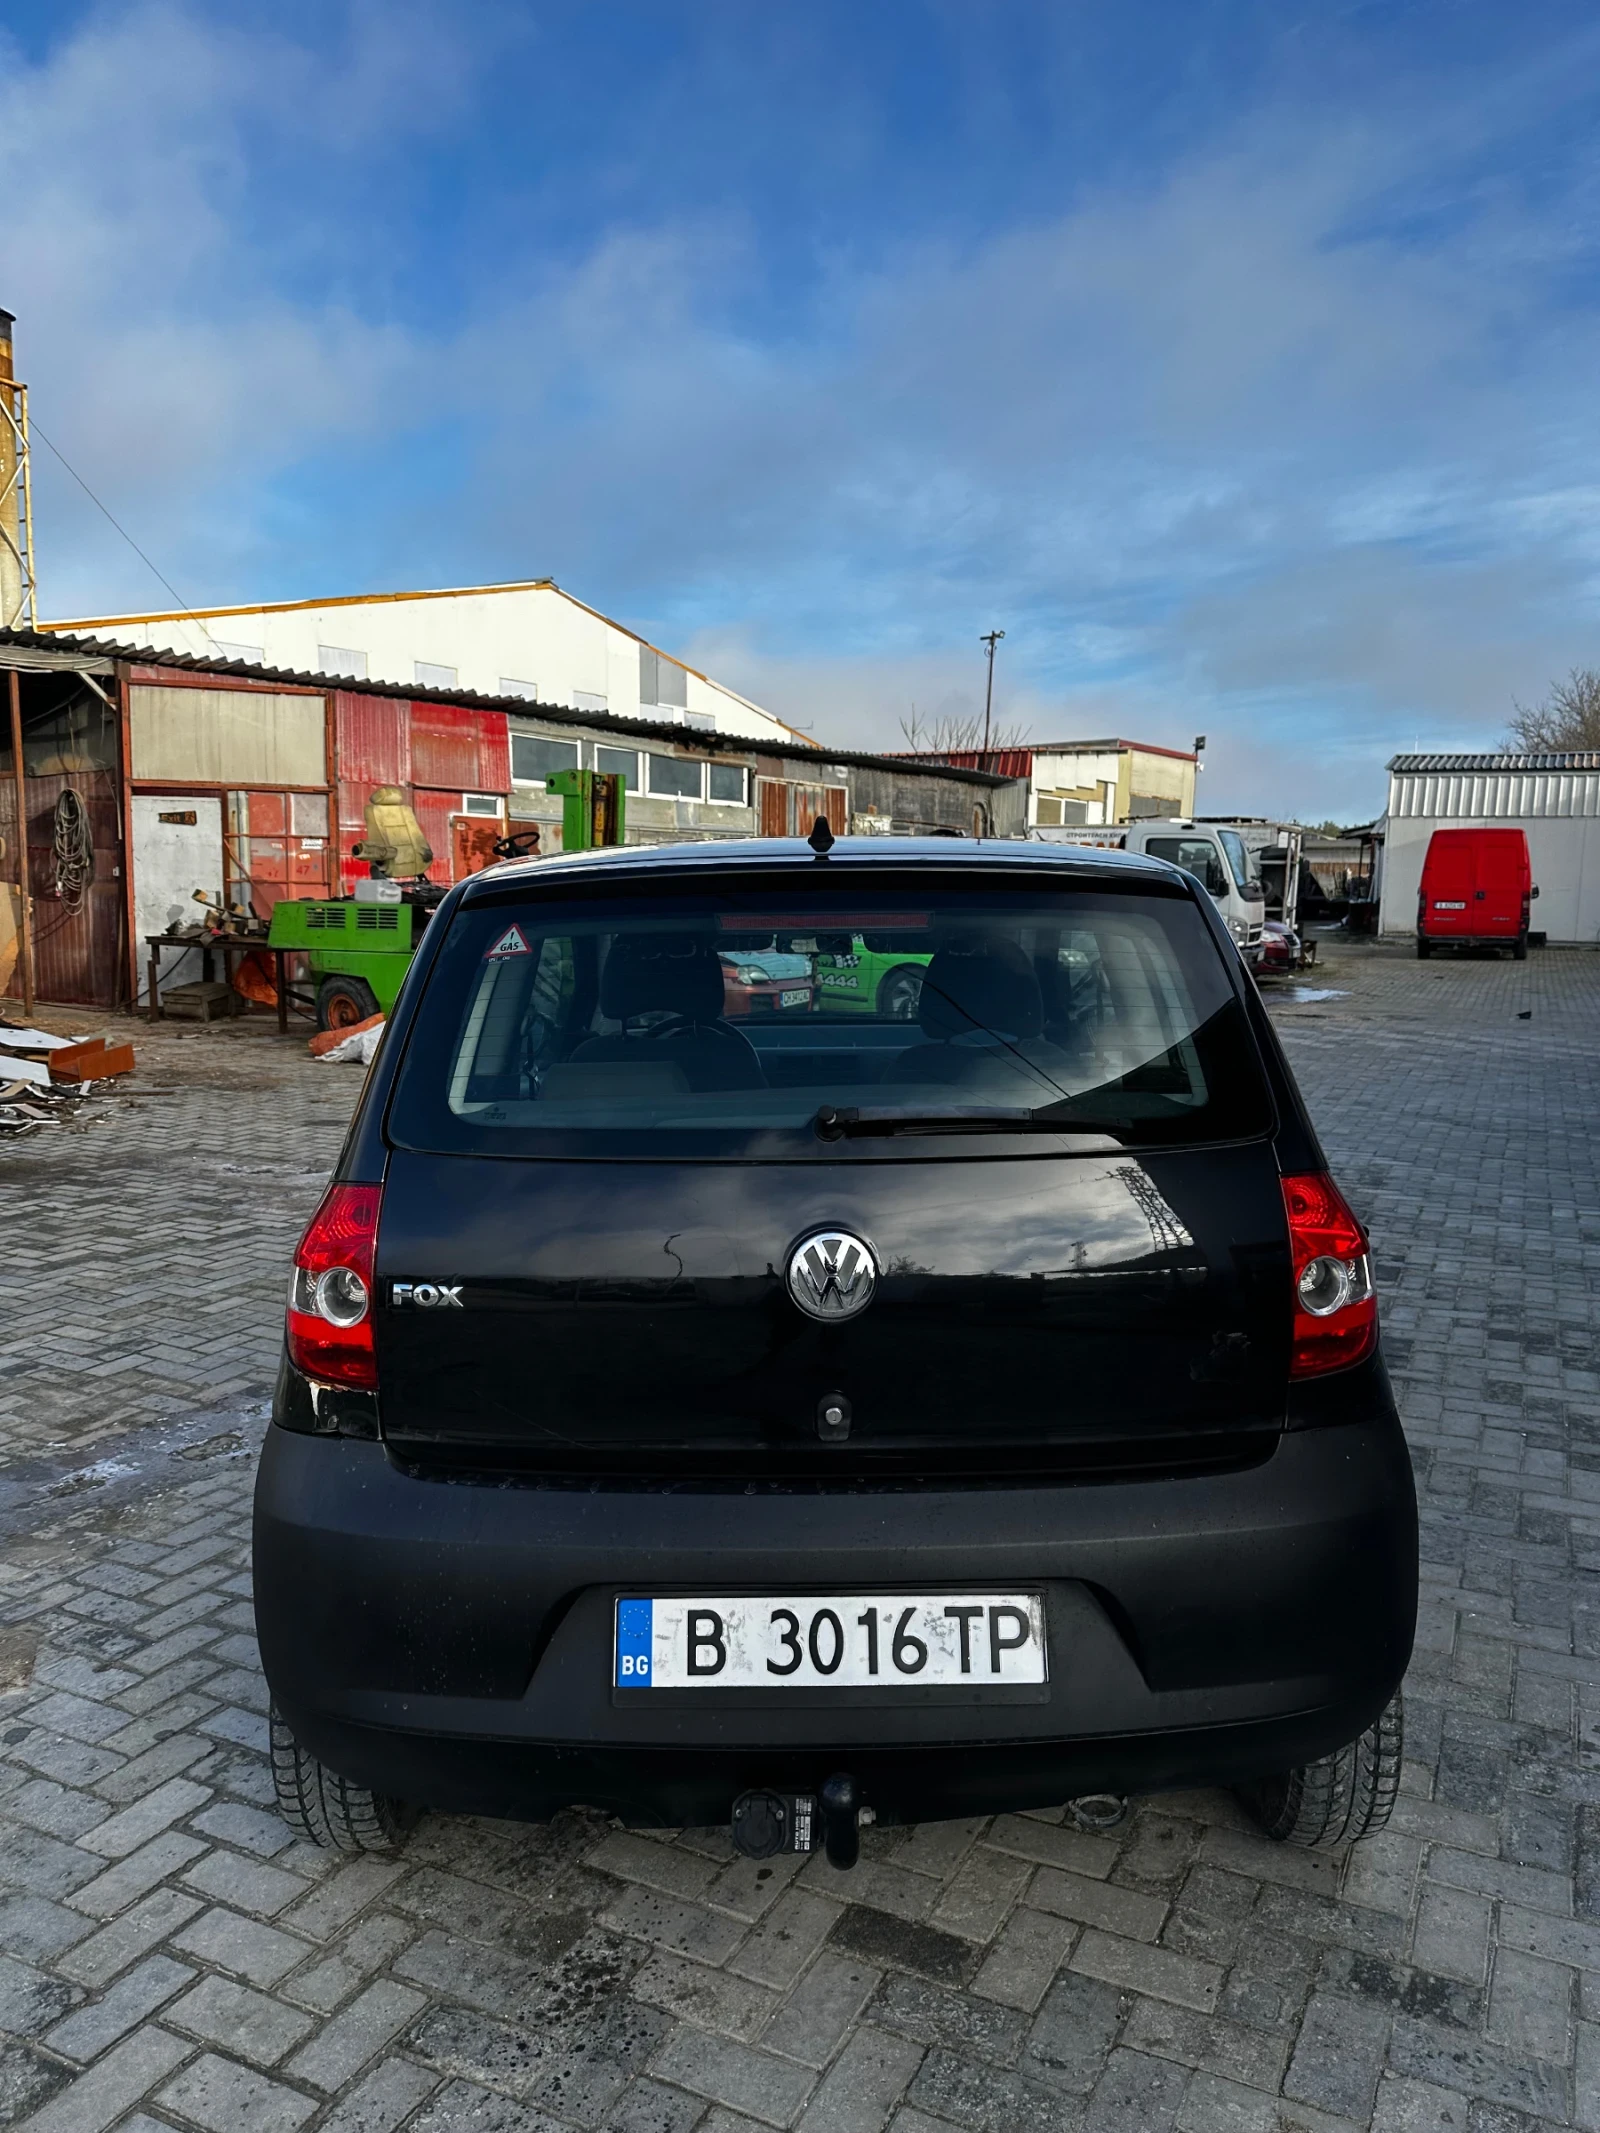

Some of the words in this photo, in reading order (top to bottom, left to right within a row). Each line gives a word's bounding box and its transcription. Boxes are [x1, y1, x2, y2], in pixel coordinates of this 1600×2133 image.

[500, 941, 519, 951] GAS
[393, 1283, 464, 1307] FOX
[686, 1609, 727, 1676] B
[621, 1655, 649, 1676] BG
